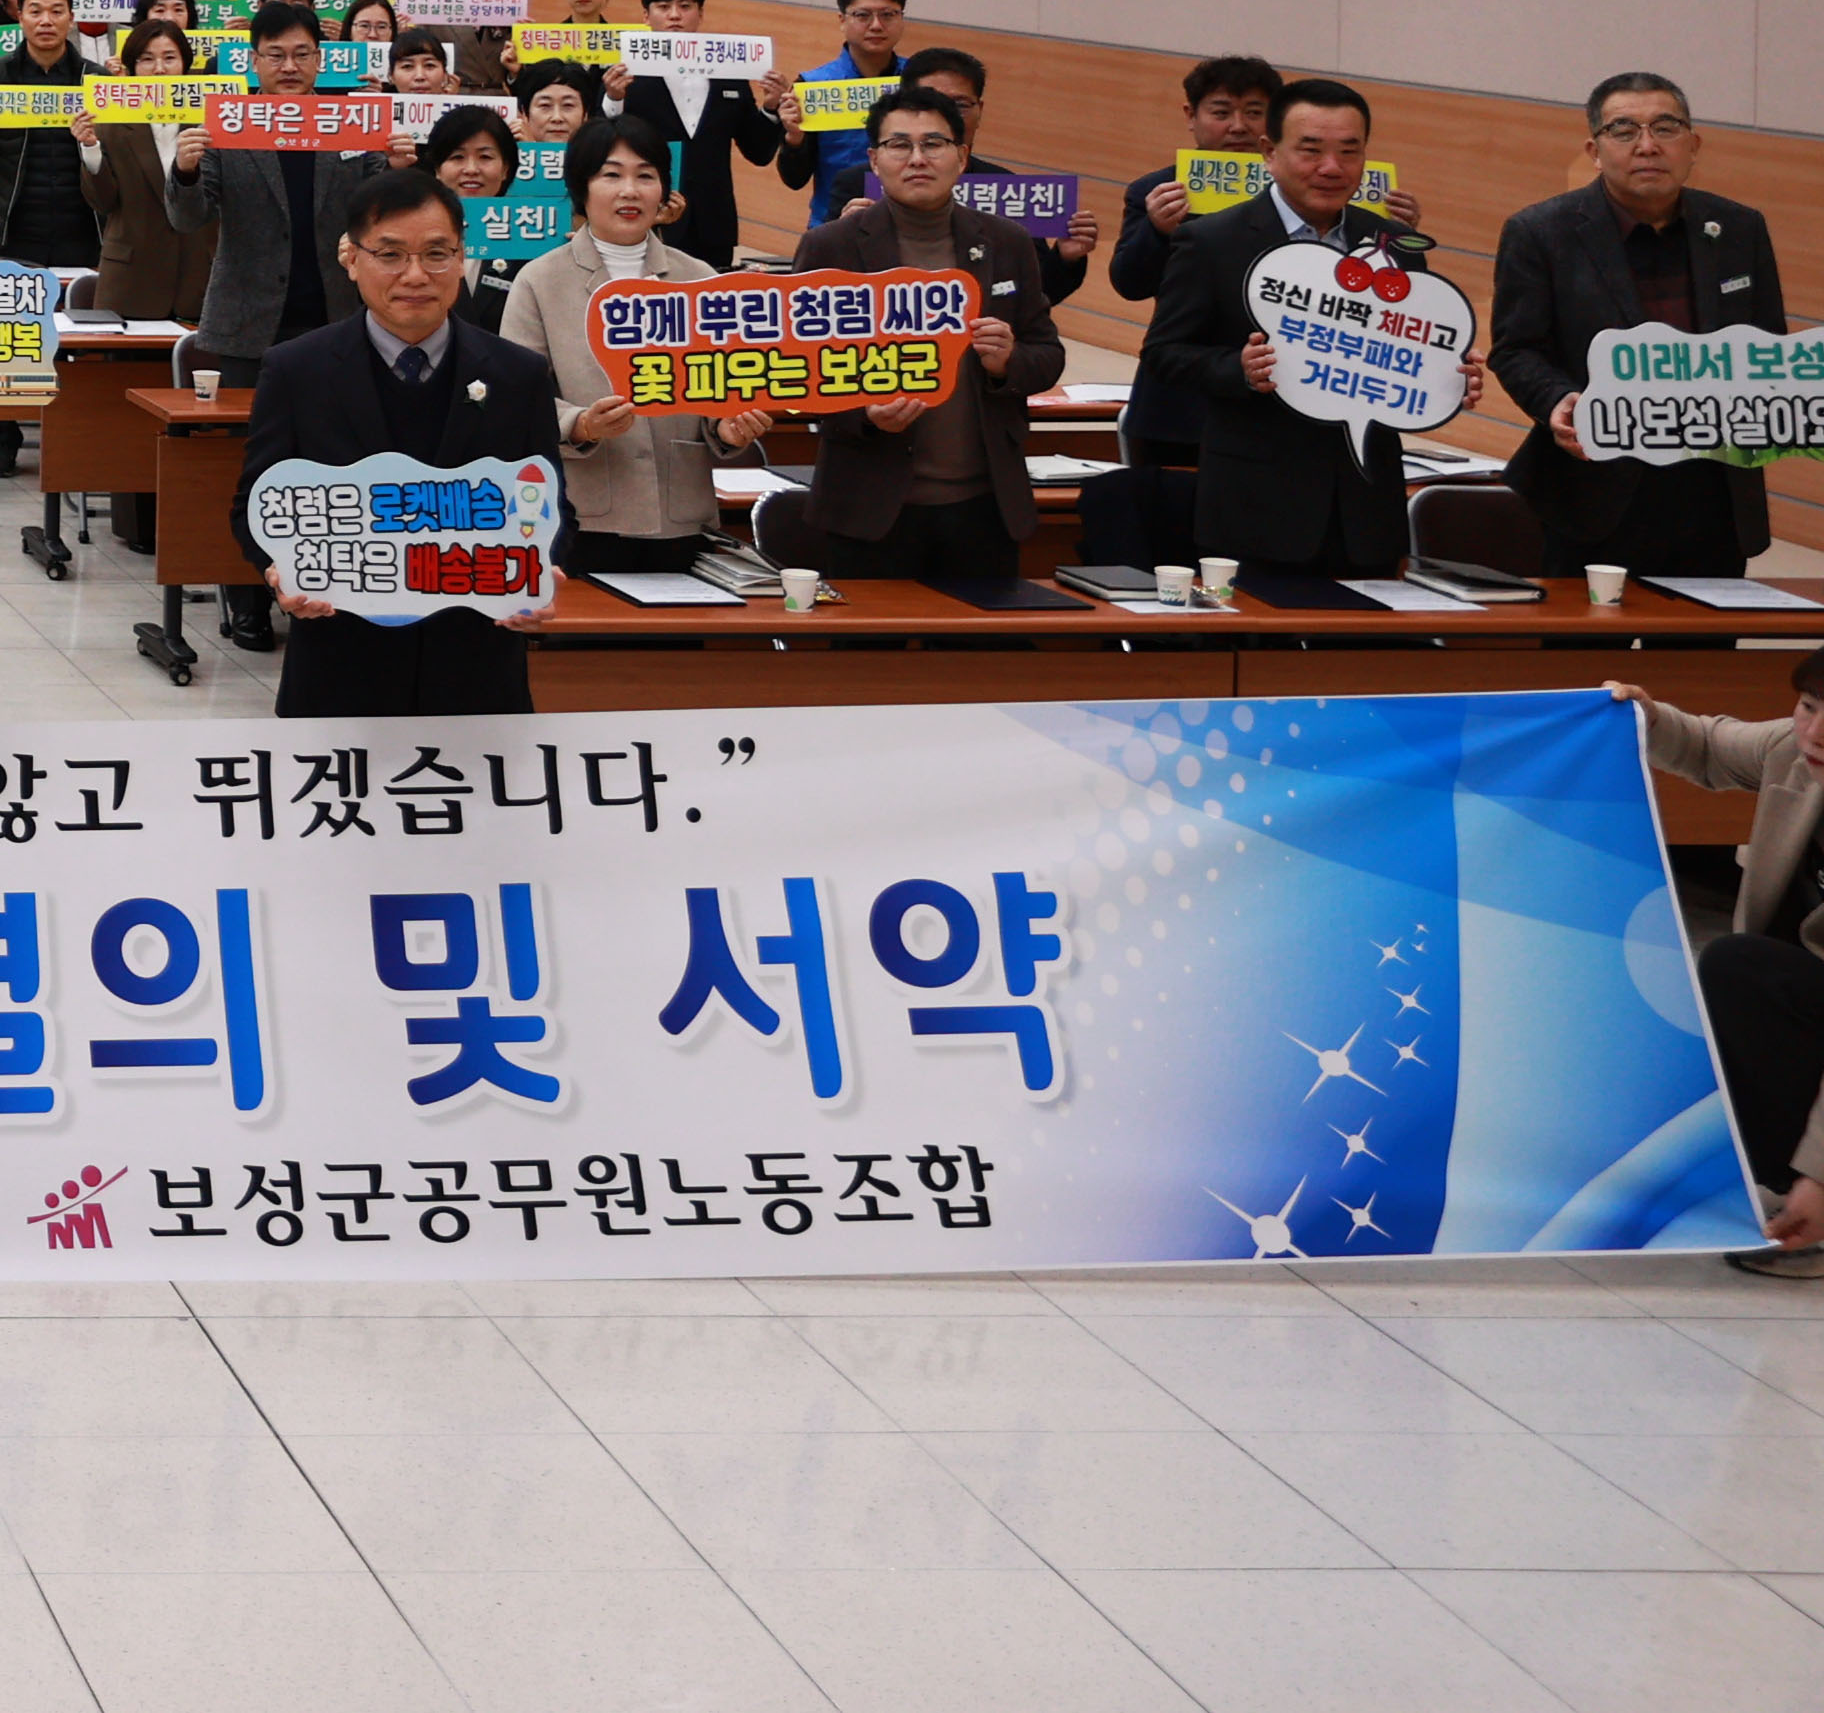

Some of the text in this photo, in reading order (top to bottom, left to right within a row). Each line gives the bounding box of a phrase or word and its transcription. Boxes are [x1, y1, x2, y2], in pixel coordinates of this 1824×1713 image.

[629, 37, 672, 61] 부정부패
[703, 41, 747, 64] 긍정사회
[749, 43, 765, 64] UP
[217, 100, 382, 135] 청탁은 금지!
[480, 205, 556, 240] 실천!
[601, 280, 967, 348] 함께 뿌린 청렴 씨앗
[1259, 276, 1459, 353] 정신 바짝 체리고
[631, 342, 940, 405] 꽃 피우는 보성군
[1277, 314, 1424, 379] 부정부패와
[1611, 341, 1734, 382] 이래서
[1300, 359, 1429, 417] 거리두기!
[258, 477, 507, 538] 청렴은 로켓배송
[294, 538, 543, 597] 청탁은 배송불가
[367, 881, 562, 1106] 및
[655, 868, 1064, 1101] 서약
[147, 1142, 996, 1247] 보성군공무원노동조합
